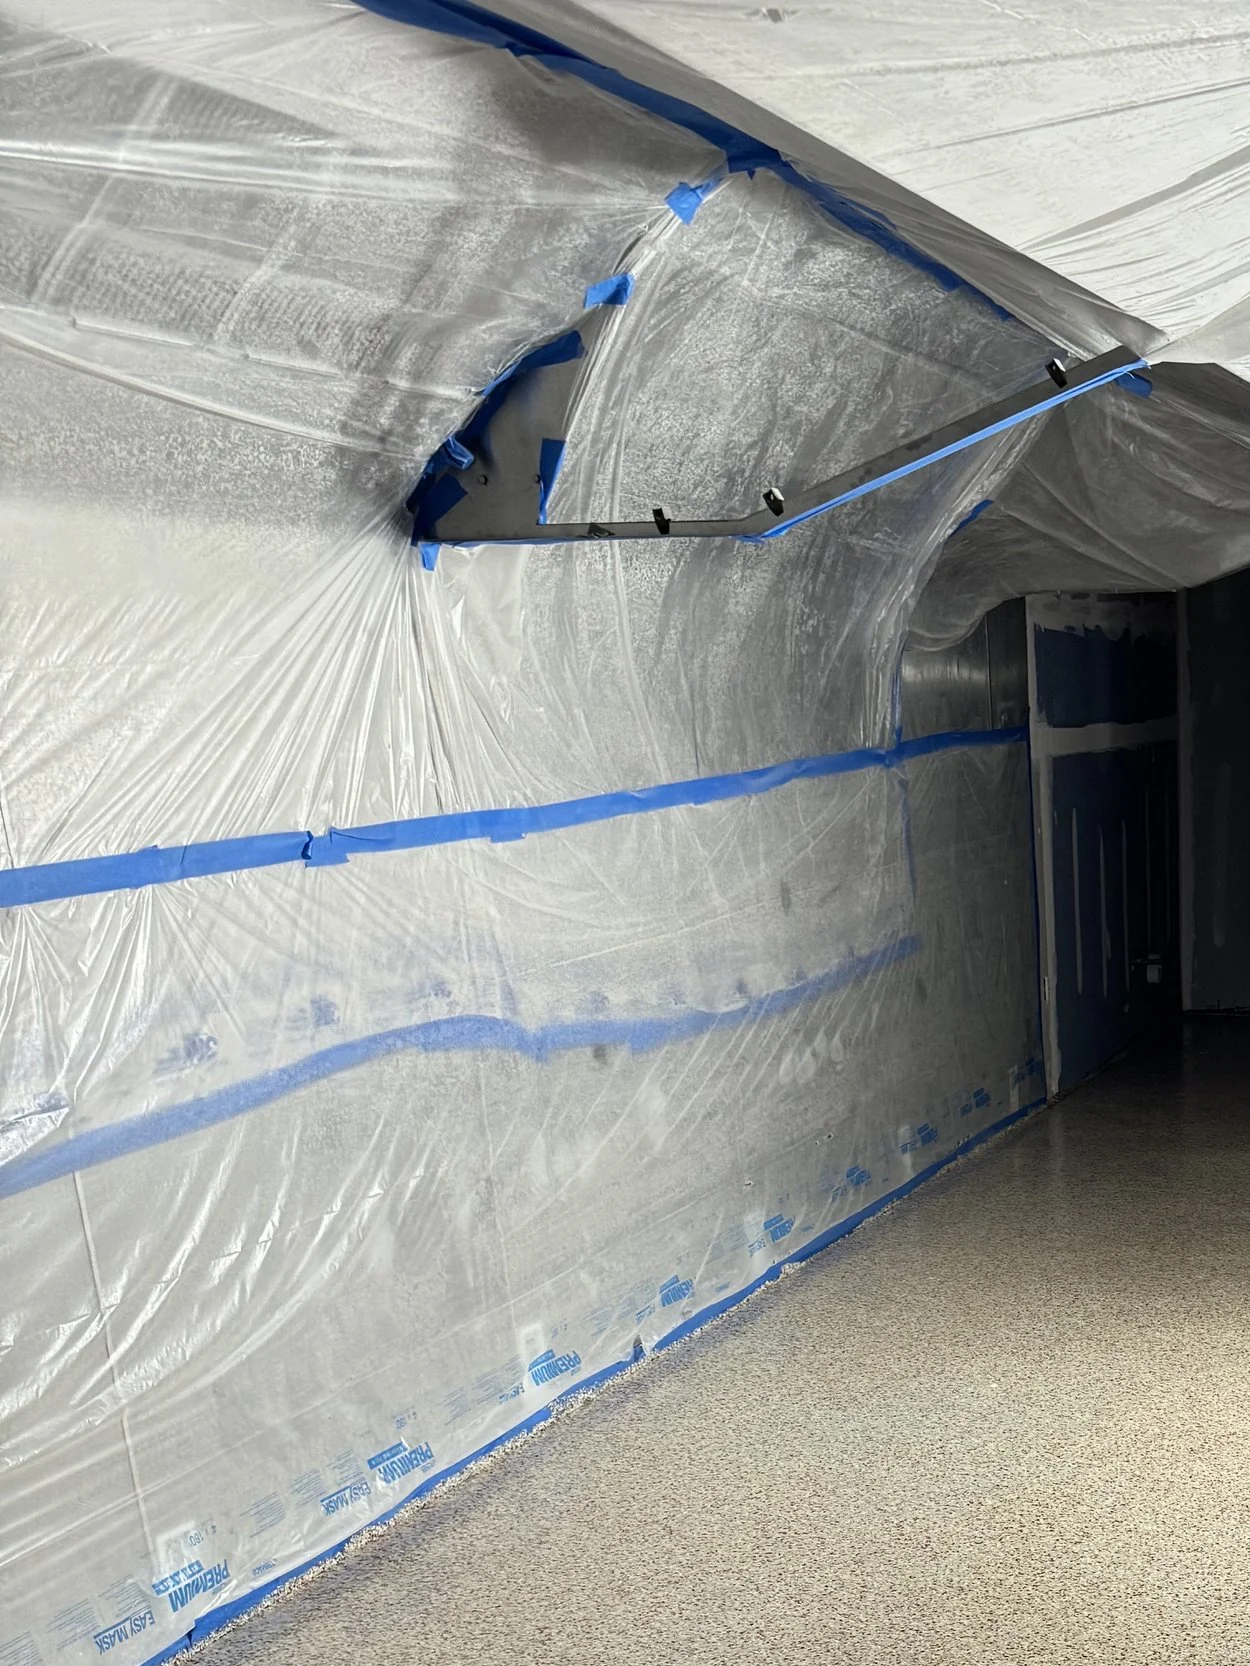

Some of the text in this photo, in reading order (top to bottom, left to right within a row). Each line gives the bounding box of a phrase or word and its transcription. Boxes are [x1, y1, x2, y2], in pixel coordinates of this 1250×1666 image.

[531, 1350, 582, 1387] PREMIUM
[377, 1441, 434, 1485] PREMIUM
[320, 1492, 349, 1517] MASK
[349, 1481, 372, 1505] EASY
[168, 1559, 230, 1614] PREMIUM
[129, 1610, 156, 1637] EASY
[95, 1624, 129, 1656] MASK
